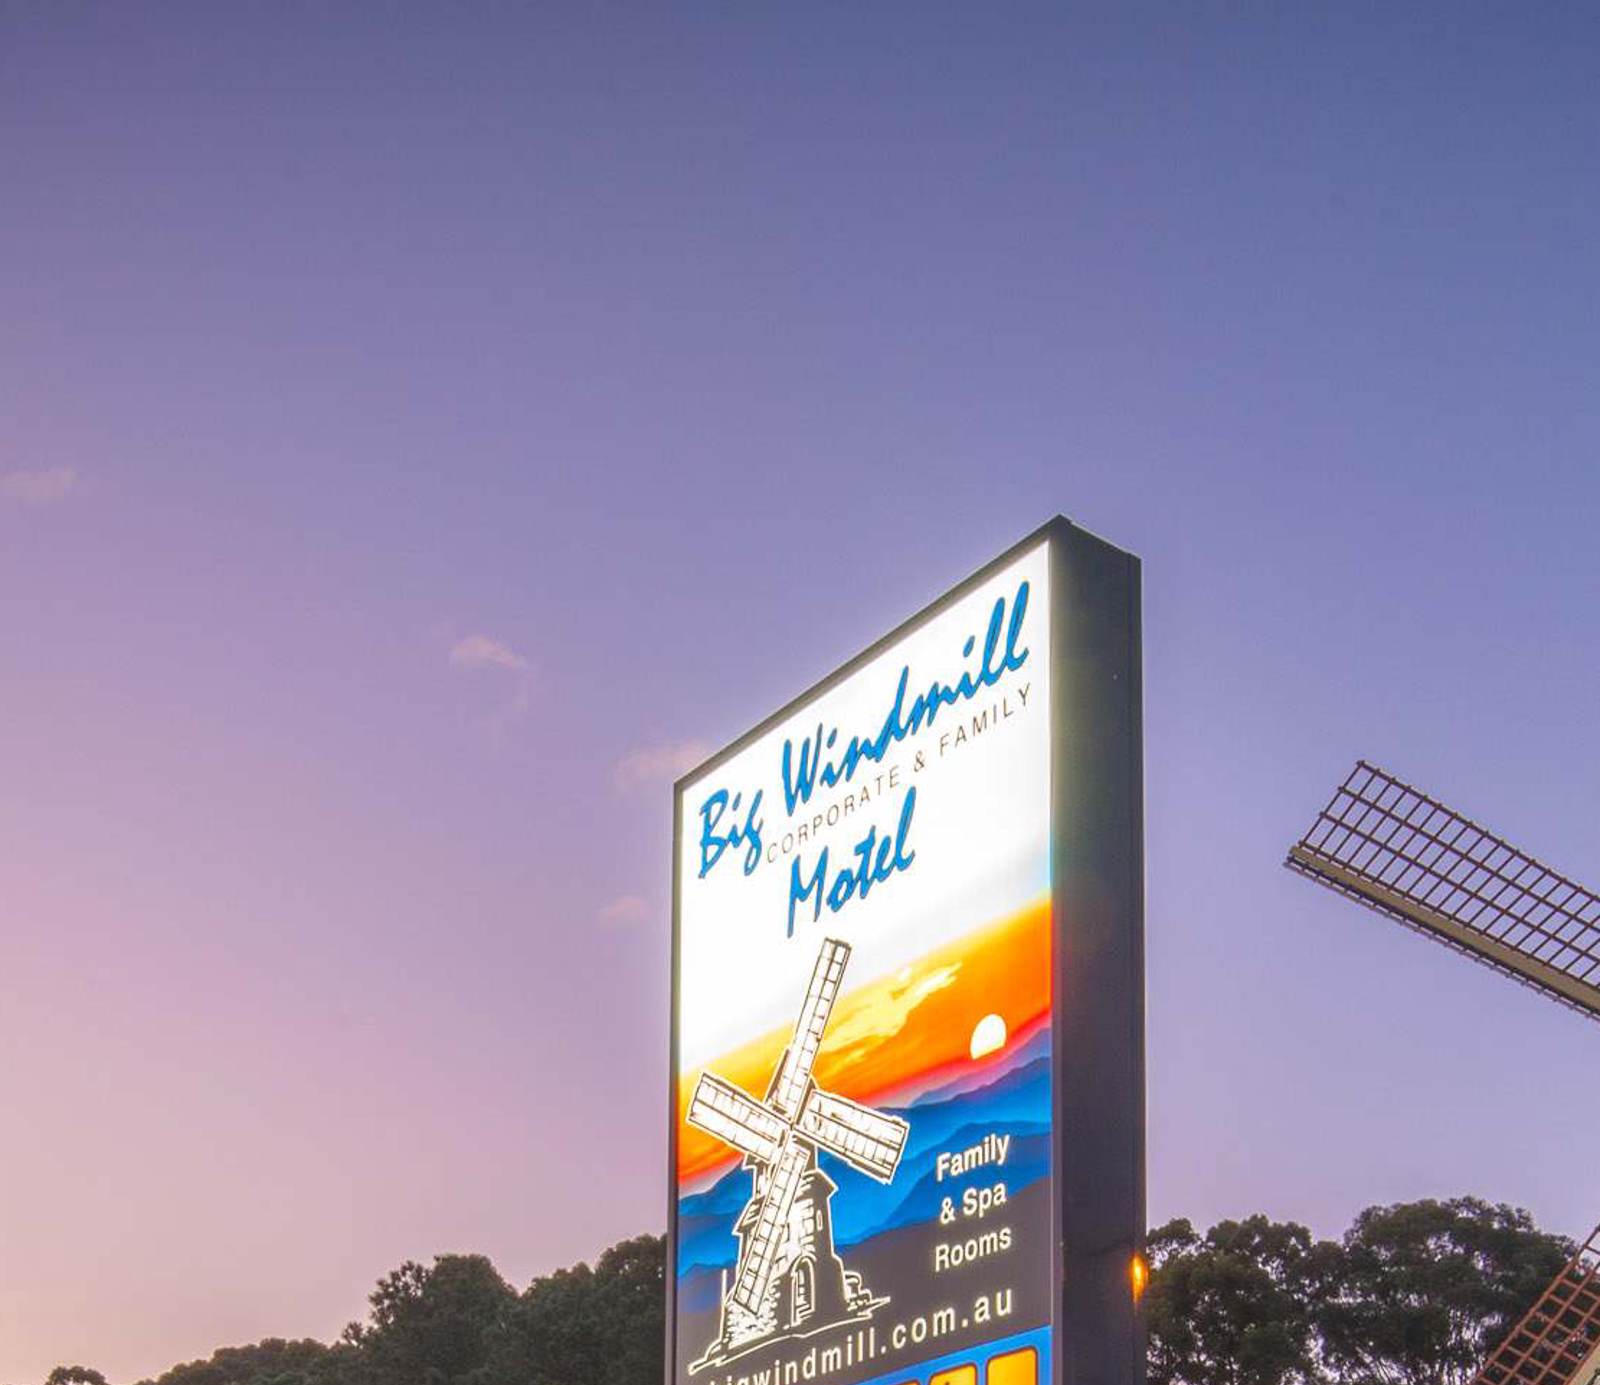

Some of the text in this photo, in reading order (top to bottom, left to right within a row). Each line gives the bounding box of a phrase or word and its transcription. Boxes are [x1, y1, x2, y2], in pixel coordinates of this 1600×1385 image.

[698, 581, 1029, 879] Big Windmill
[767, 682, 1031, 863] CORPORATE & FAMILY
[787, 786, 916, 938] Motel
[936, 1132, 1011, 1183] Family
[939, 1182, 1008, 1225] & Spa
[935, 1226, 1012, 1273] Rooms
